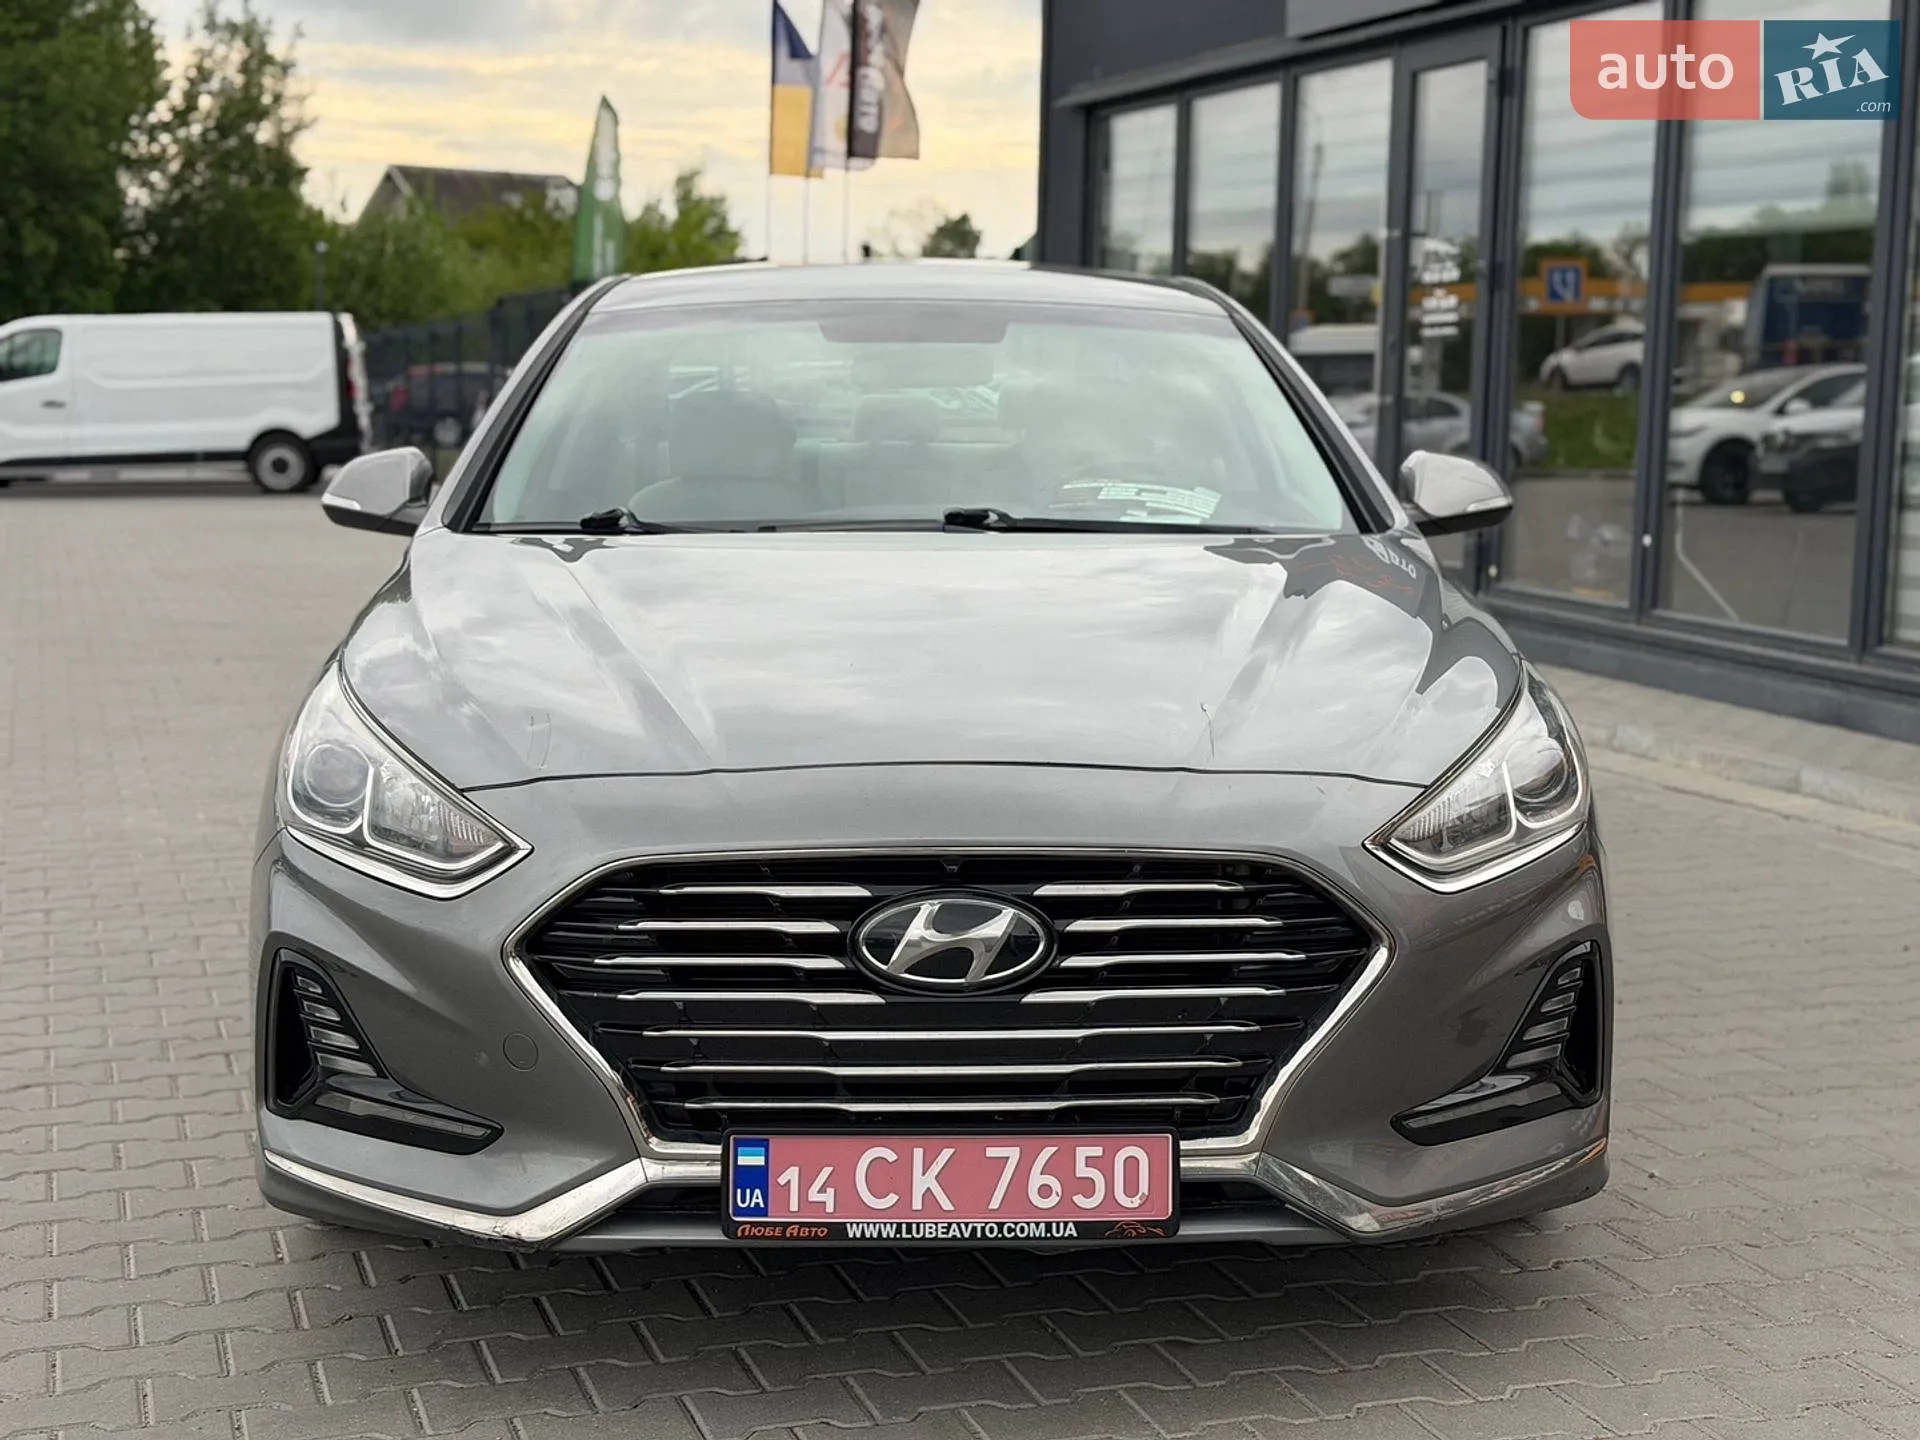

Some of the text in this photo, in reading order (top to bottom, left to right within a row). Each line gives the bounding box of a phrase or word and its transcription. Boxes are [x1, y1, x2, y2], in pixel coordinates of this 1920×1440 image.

[776, 1145, 1150, 1213] 14 CK 7650
[736, 1188, 765, 1208] UA
[846, 1222, 1078, 1239] WWW.LUBEAVTO.COM.UA
